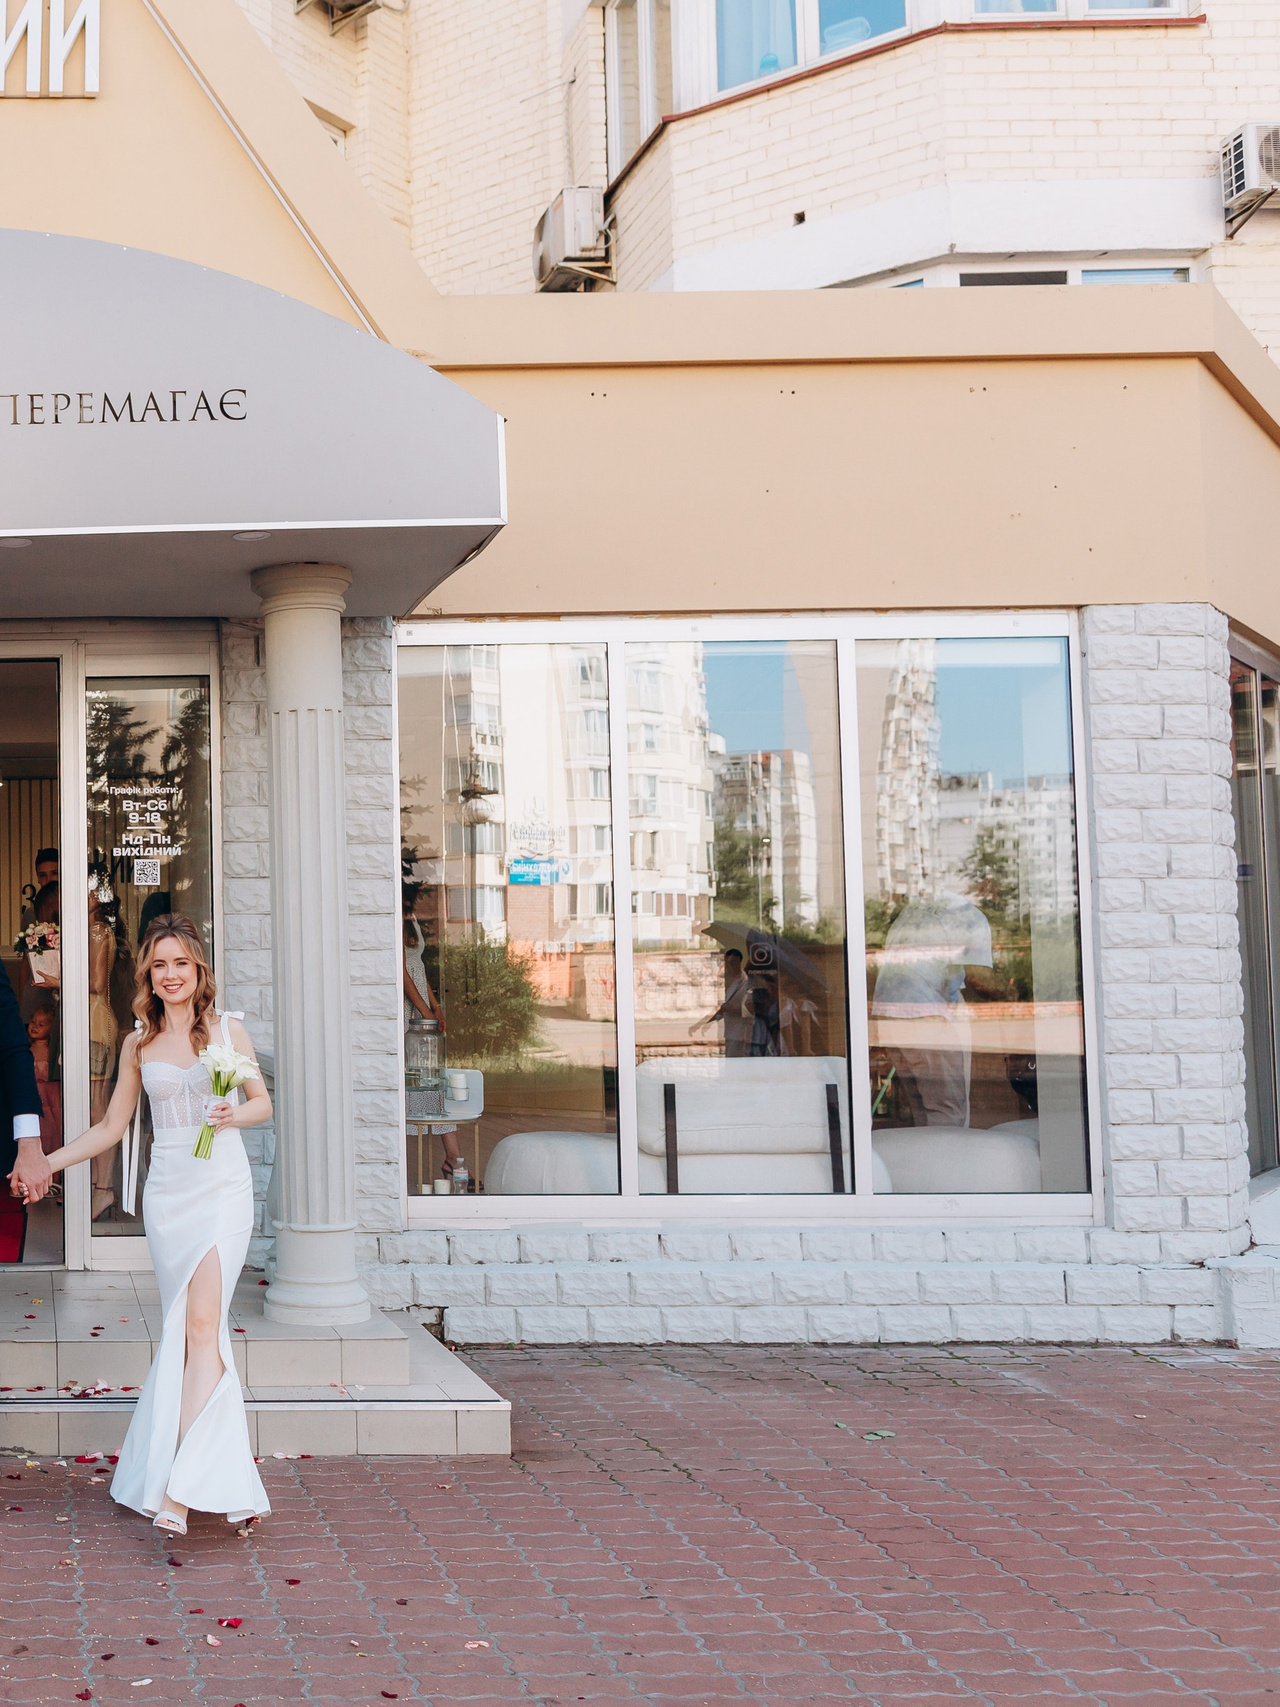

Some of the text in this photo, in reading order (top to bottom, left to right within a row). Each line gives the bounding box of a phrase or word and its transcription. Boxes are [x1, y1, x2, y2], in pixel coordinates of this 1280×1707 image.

[109, 786, 179, 795] Графік роботи:
[122, 800, 168, 812] Вт-Сб
[128, 812, 161, 824] 9-18
[121, 833, 171, 845] Нд-Пн
[112, 844, 182, 857] вихідний
